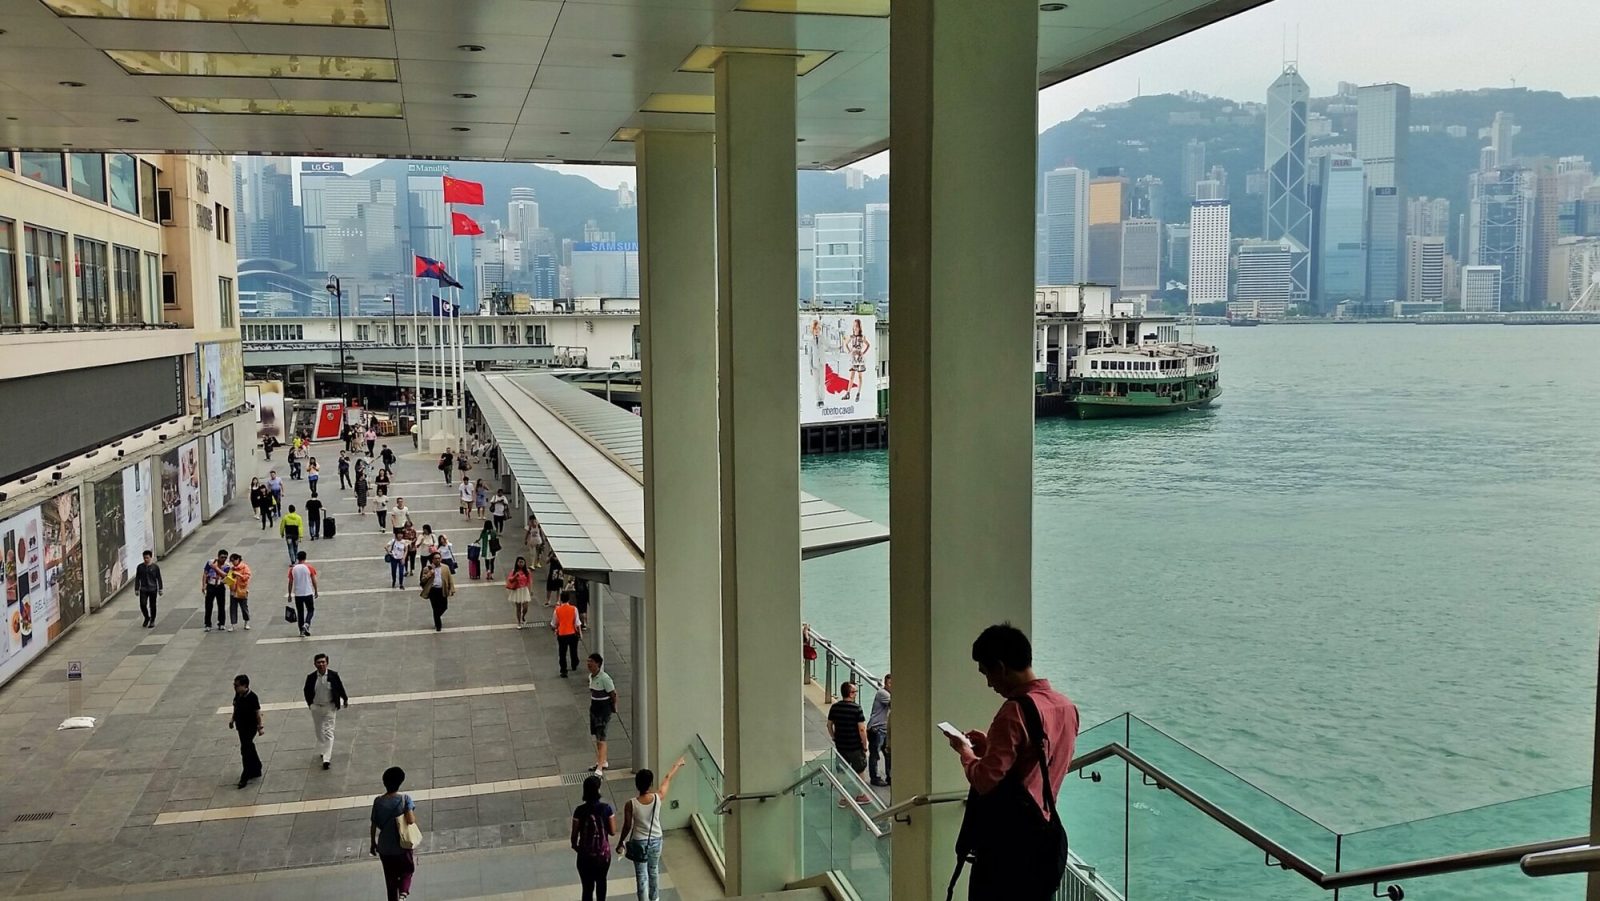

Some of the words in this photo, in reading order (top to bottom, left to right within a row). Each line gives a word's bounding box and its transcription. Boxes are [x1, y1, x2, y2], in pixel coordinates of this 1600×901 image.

[311, 163, 321, 171] LG
[416, 164, 449, 172] Manulife
[591, 242, 638, 251] SAMSUN
